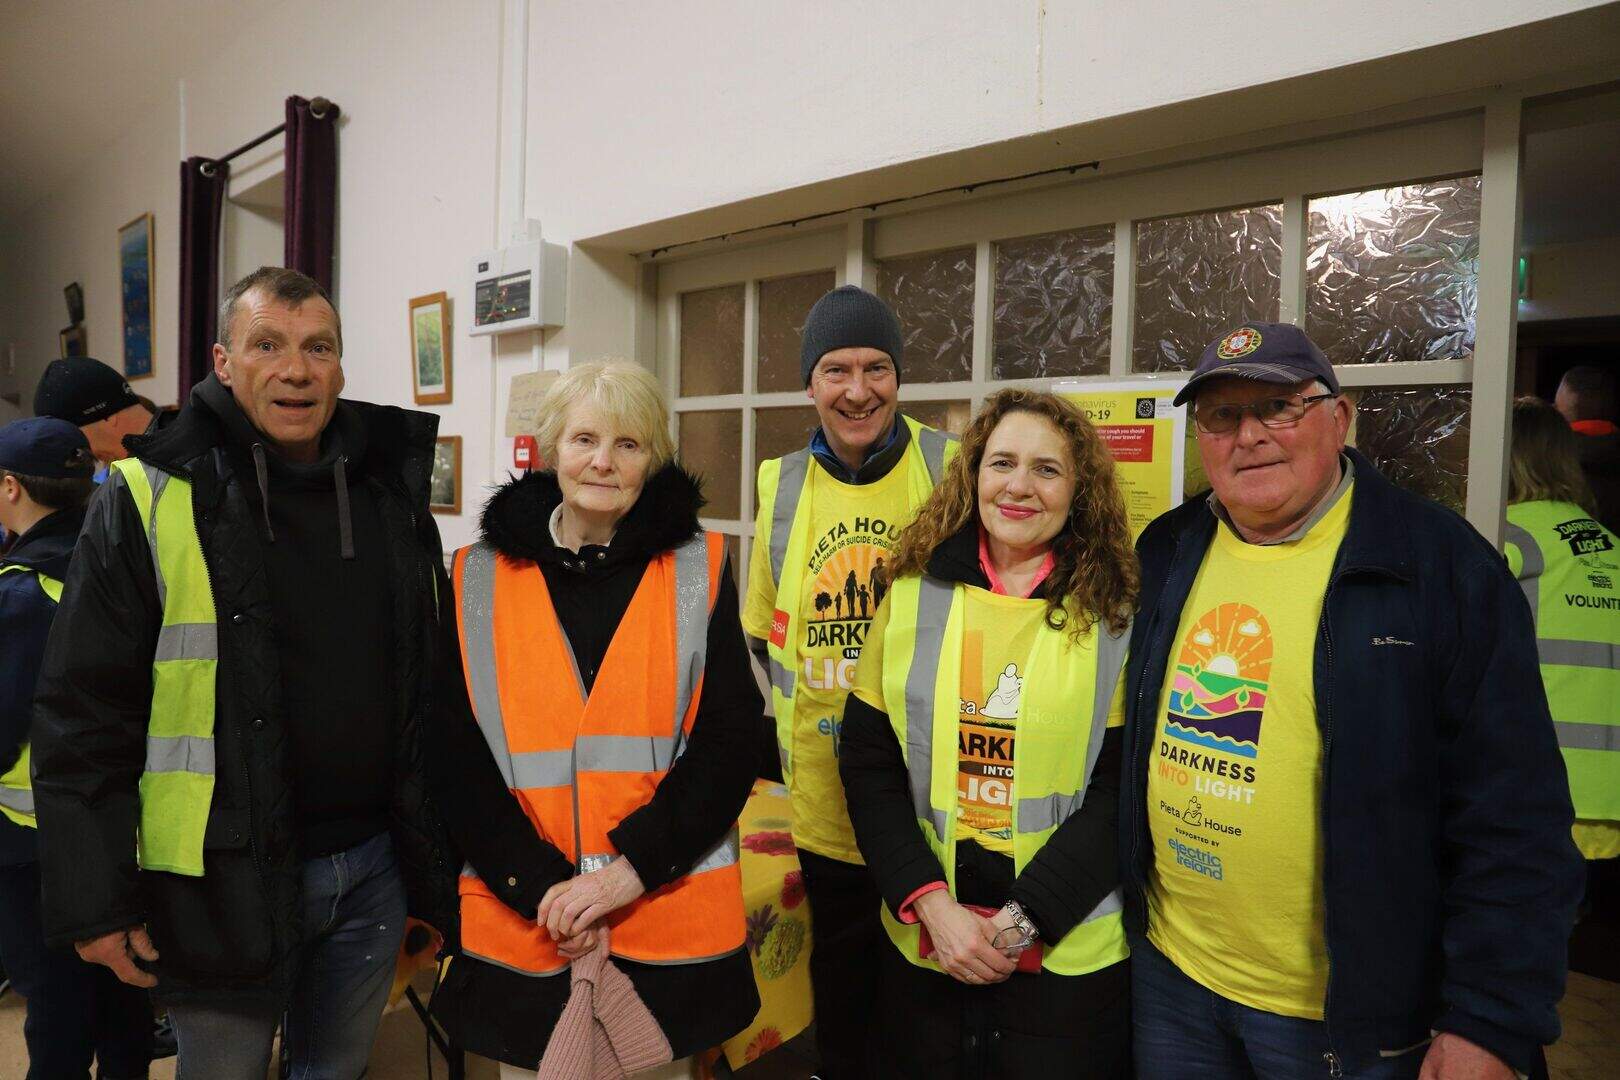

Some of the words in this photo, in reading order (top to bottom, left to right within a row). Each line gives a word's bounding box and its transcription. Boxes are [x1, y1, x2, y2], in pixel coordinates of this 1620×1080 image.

[808, 522, 848, 569] PIETA
[846, 535, 871, 546] SUICIDE
[983, 765, 1014, 778] INTO
[1160, 741, 1256, 783] DARKNESS
[958, 777, 1014, 806] IG
[1158, 761, 1189, 786] INTO
[1195, 775, 1255, 806] LIGHT
[1160, 800, 1181, 818] Pieta
[1204, 817, 1242, 836] House
[1175, 827, 1209, 844] SUPPORTED
[1168, 838, 1222, 868] electric
